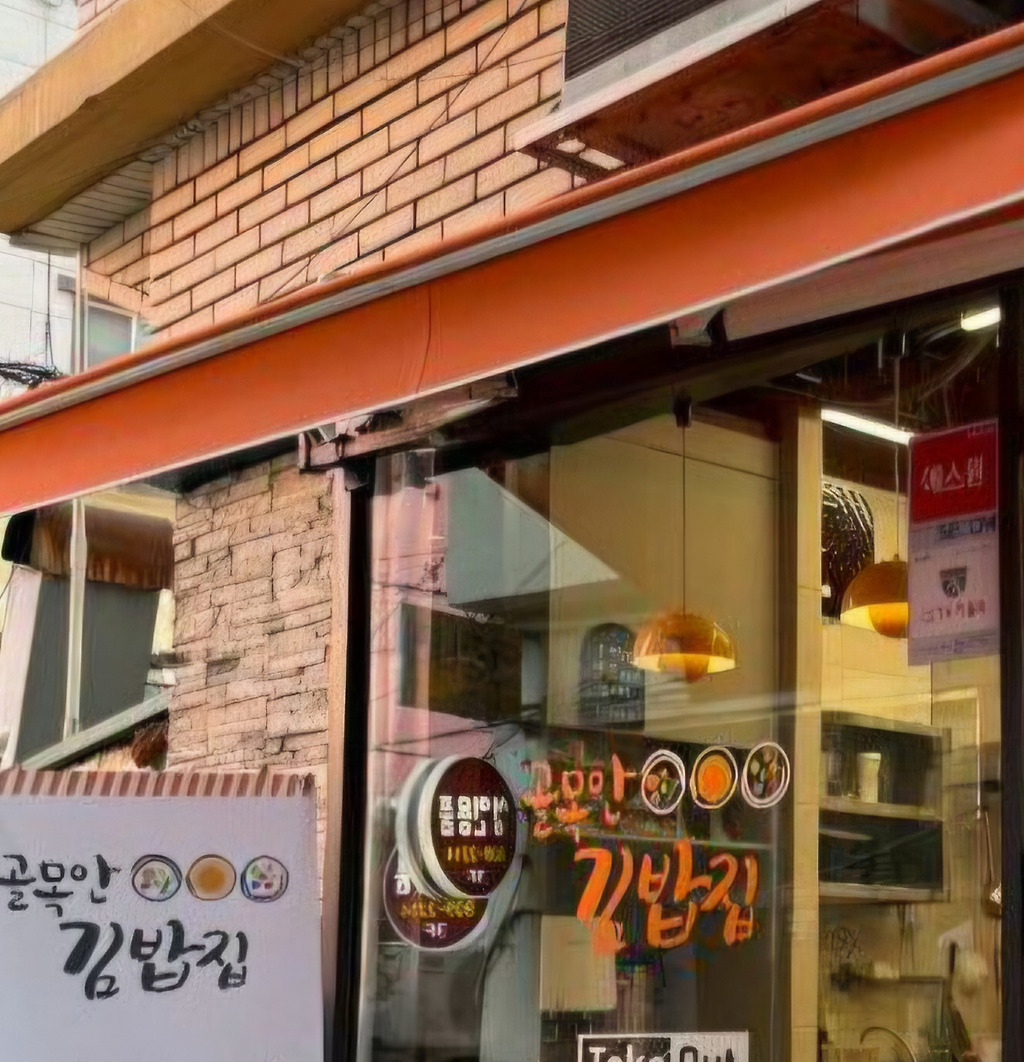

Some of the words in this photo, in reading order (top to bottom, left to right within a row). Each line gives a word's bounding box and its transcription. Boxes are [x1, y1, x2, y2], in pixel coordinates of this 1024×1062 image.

[0, 854, 121, 917] 골목안
[574, 838, 760, 955] 김밥집
[59, 919, 249, 1000] 김밥집
